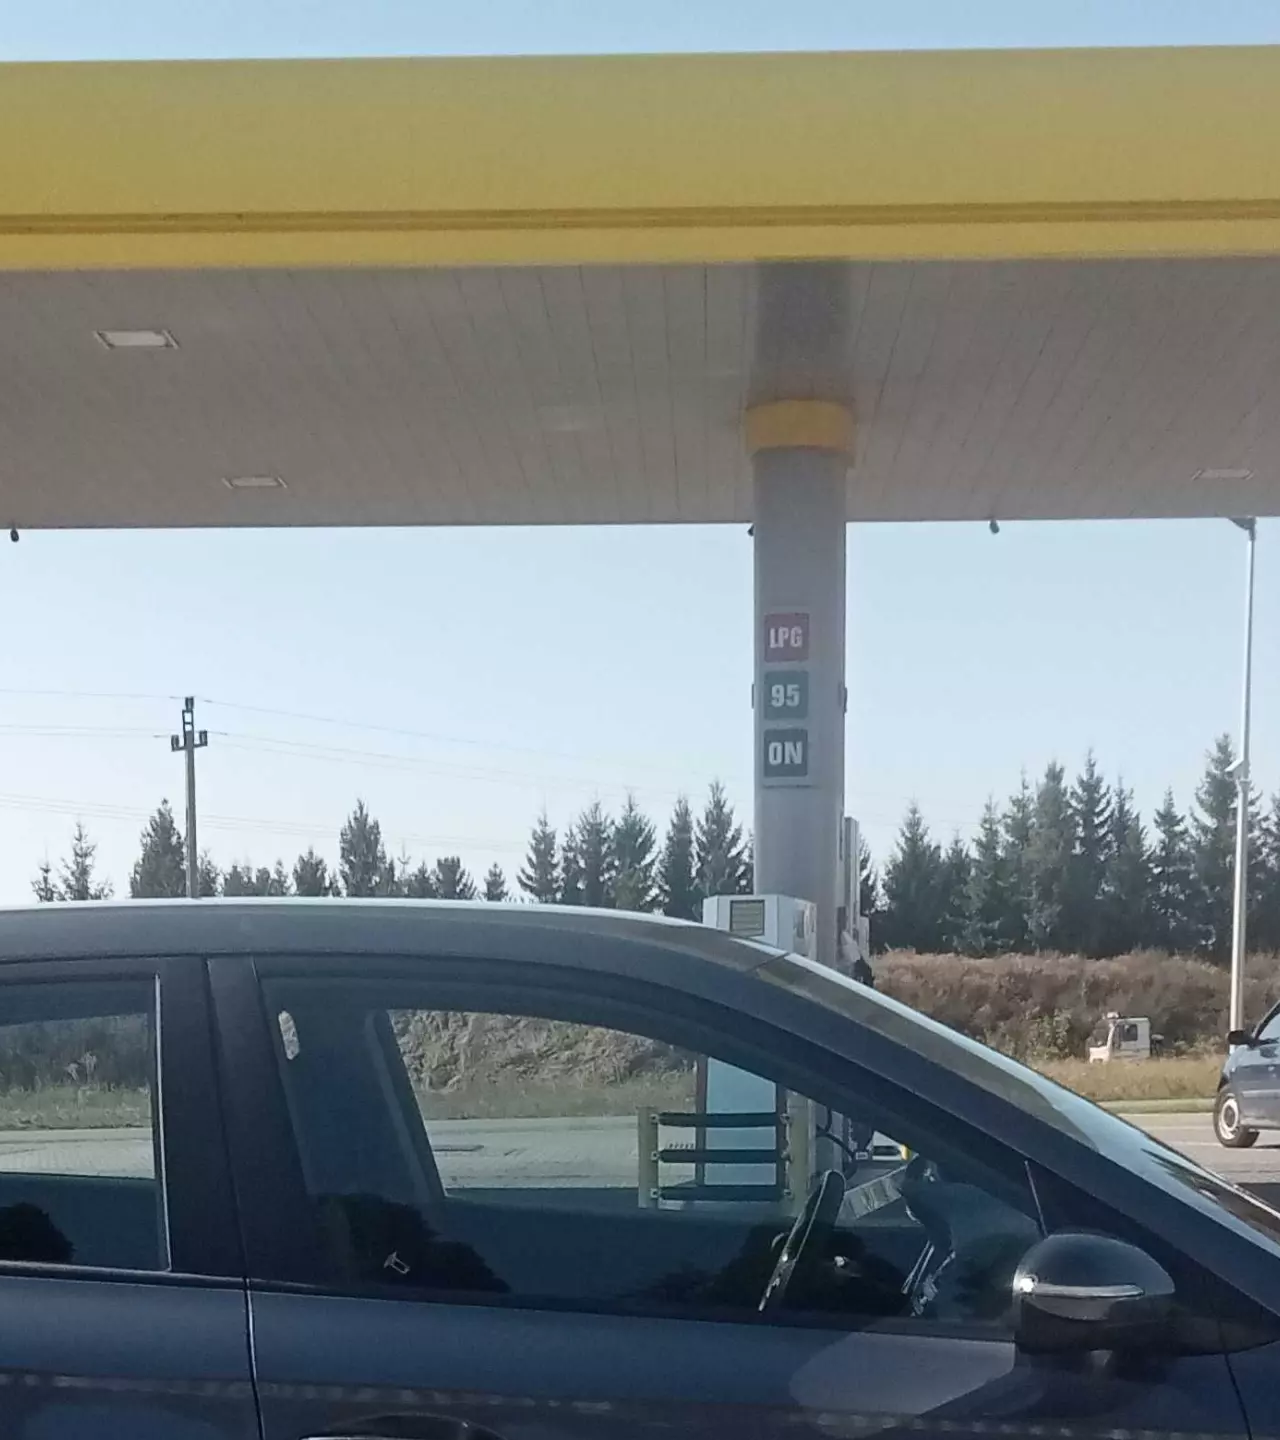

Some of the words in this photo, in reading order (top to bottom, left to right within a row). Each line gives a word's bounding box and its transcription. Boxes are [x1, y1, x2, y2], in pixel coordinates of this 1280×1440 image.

[770, 626, 803, 649] LPG
[771, 684, 800, 708] 95
[768, 740, 803, 766] ON
